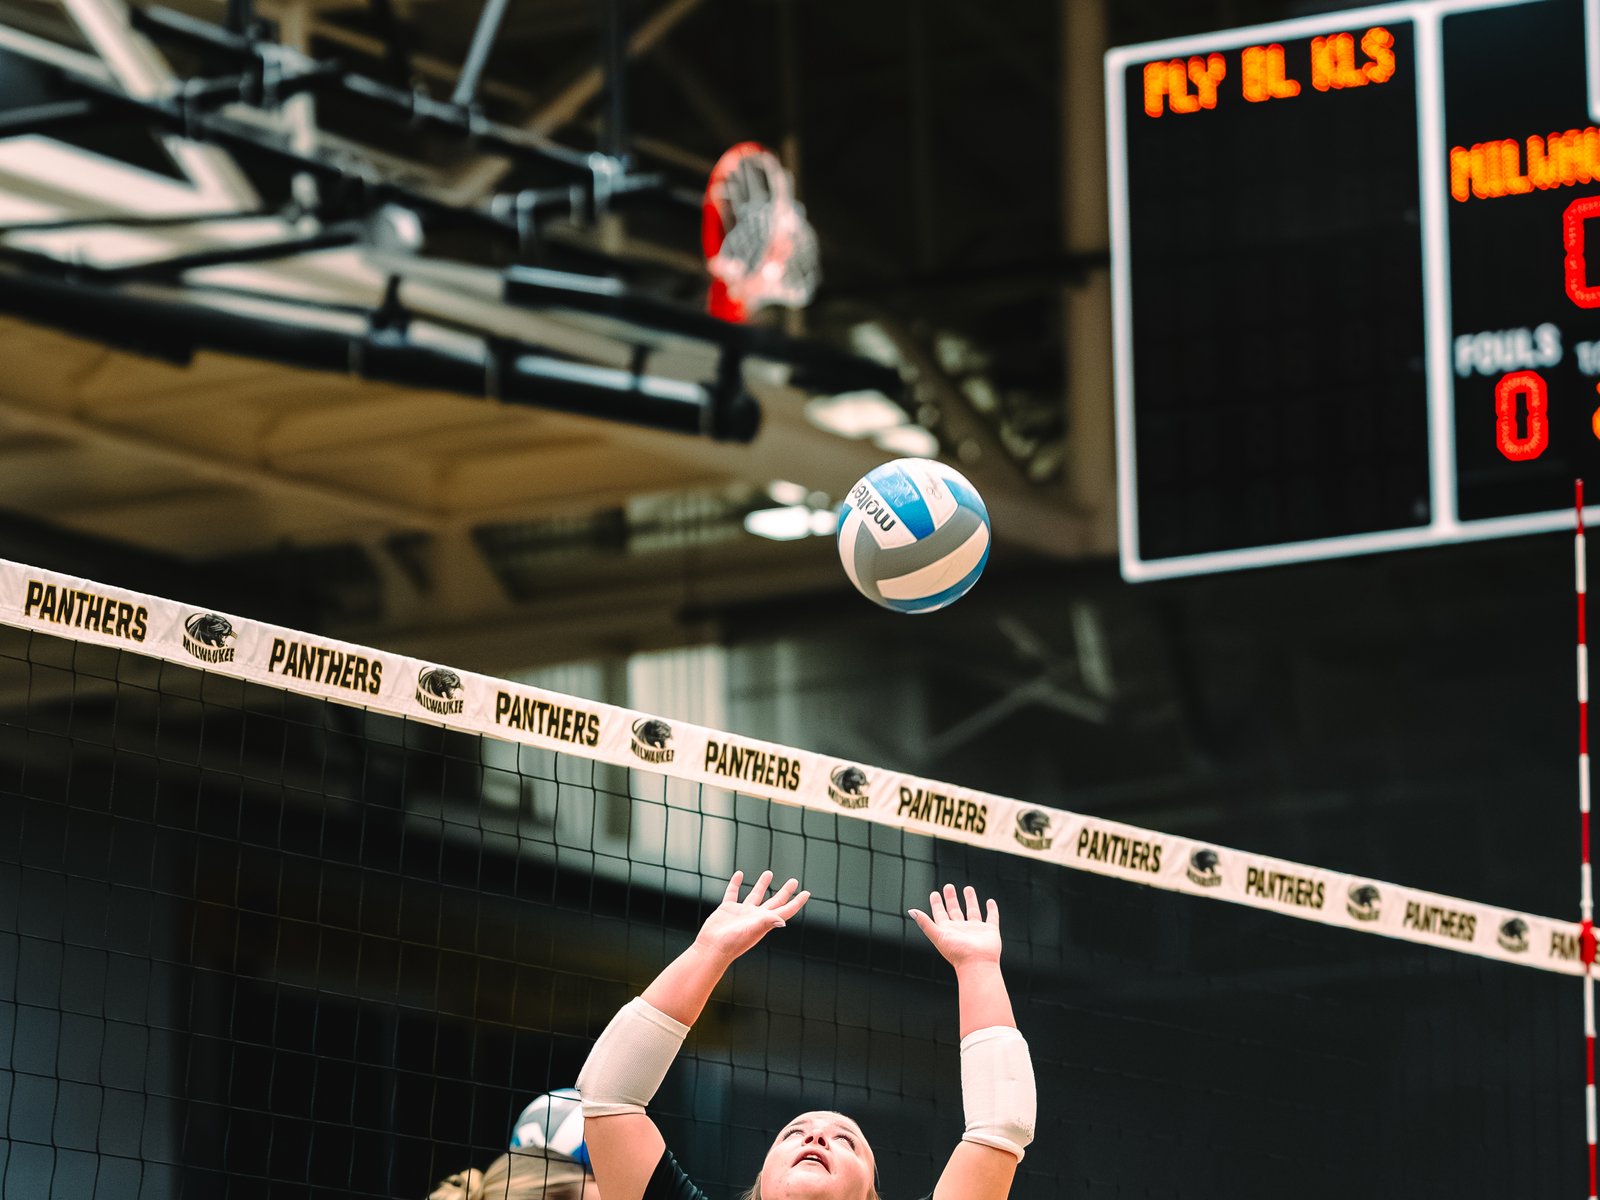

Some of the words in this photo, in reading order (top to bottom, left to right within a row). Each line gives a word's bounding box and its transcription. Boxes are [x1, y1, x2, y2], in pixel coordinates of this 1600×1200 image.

[1454, 322, 1563, 378] FOULS
[1494, 369, 1549, 462] 0
[25, 579, 149, 643] PANTHERS
[182, 633, 235, 663] MILWAUKEE
[268, 637, 384, 695] PANTHERS
[414, 690, 465, 716] MILWAUKEE
[495, 690, 601, 747] PANTHERS
[704, 740, 801, 791] PANTHERS
[897, 786, 988, 834] PANTHERS
[1076, 828, 1162, 874] PANTHERS
[1245, 866, 1326, 912] PANTHERS
[1402, 900, 1477, 943] PANTHERS
